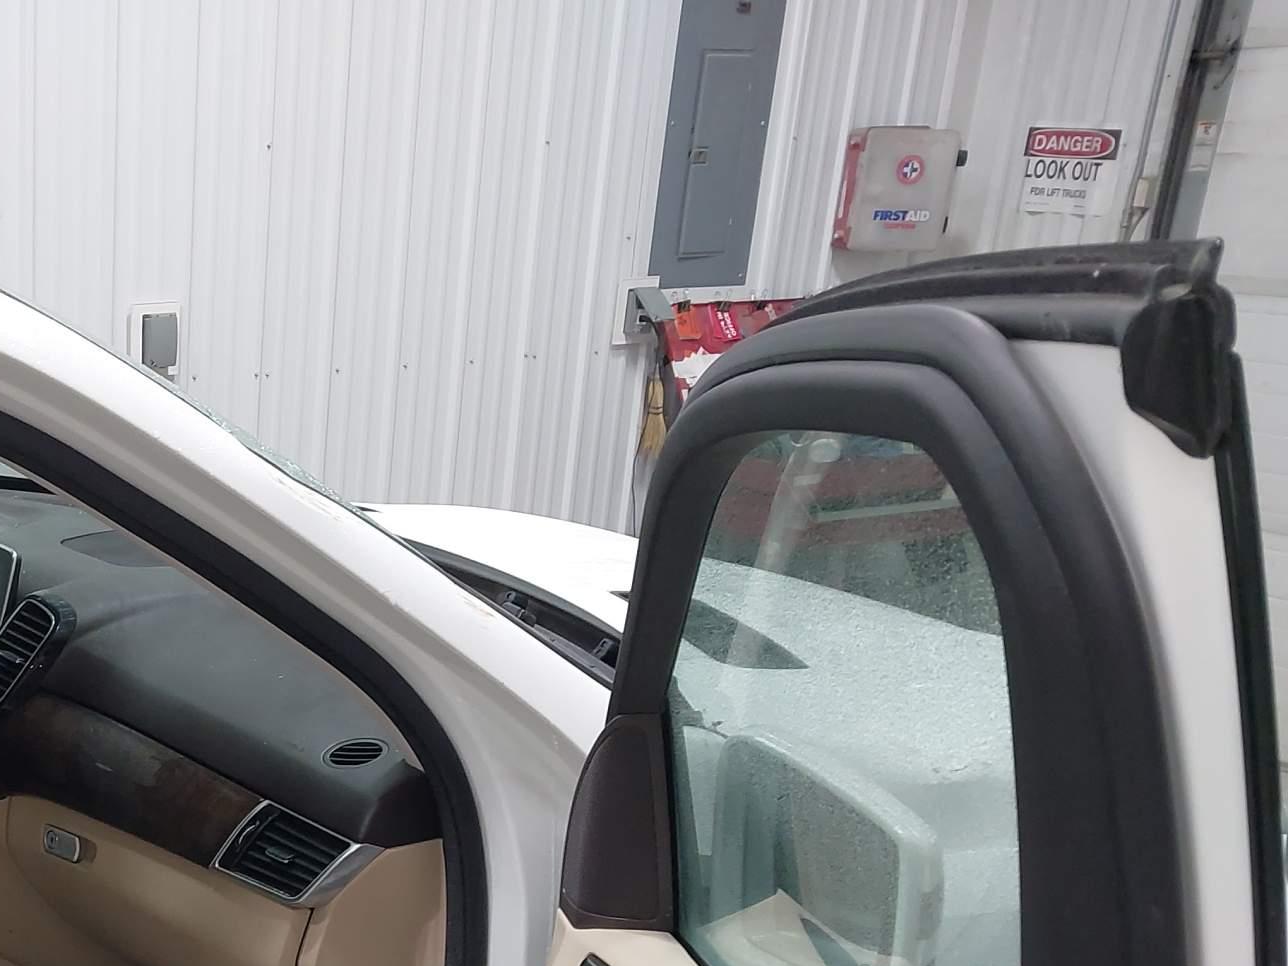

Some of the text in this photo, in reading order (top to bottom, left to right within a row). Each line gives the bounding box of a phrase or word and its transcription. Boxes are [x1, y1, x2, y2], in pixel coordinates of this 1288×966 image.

[1033, 135, 1102, 153] DANGER
[1024, 159, 1104, 182] LOOK OUT
[1046, 188, 1061, 197] LIFT
